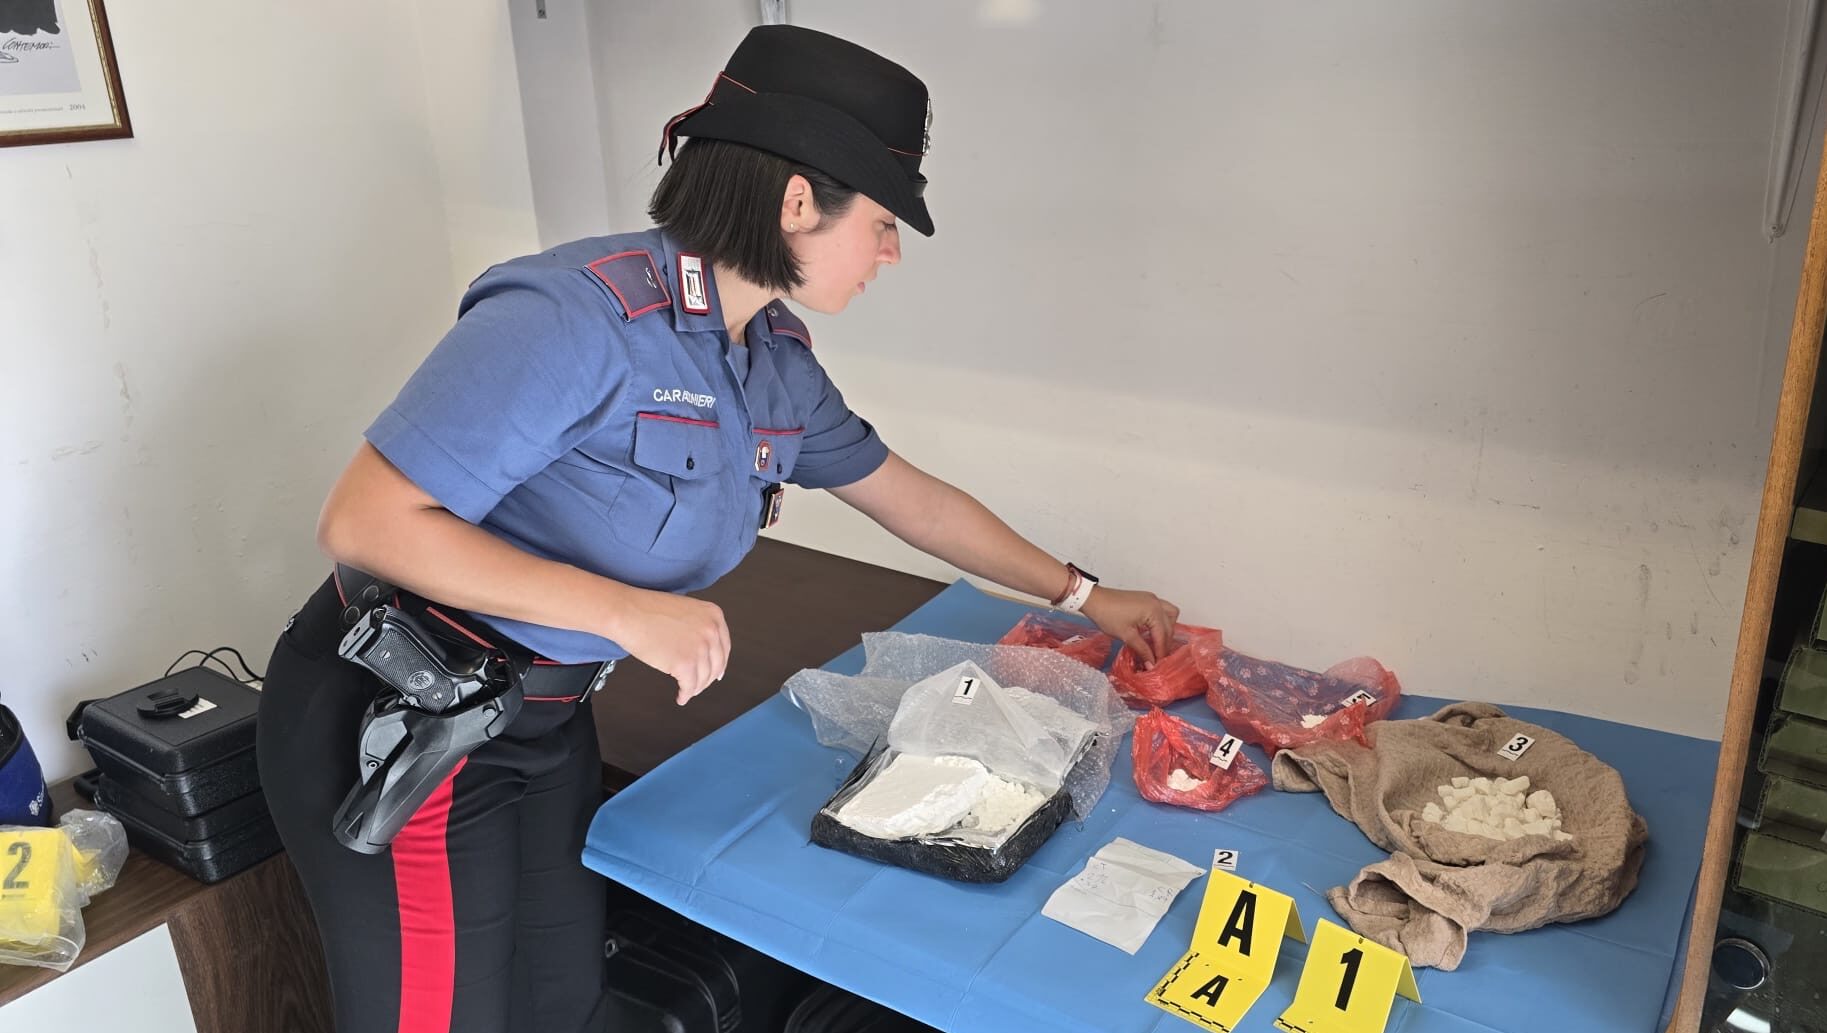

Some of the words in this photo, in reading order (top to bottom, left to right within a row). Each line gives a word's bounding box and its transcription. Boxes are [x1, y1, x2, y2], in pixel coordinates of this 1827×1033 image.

[963, 678, 974, 696] 1
[1219, 738, 1235, 757] 4
[1508, 736, 1529, 752] 3
[3, 841, 32, 890] 2
[1217, 851, 1233, 865] 2
[1217, 889, 1257, 957] A
[1190, 974, 1230, 1008] A
[1335, 947, 1364, 1012] 1
